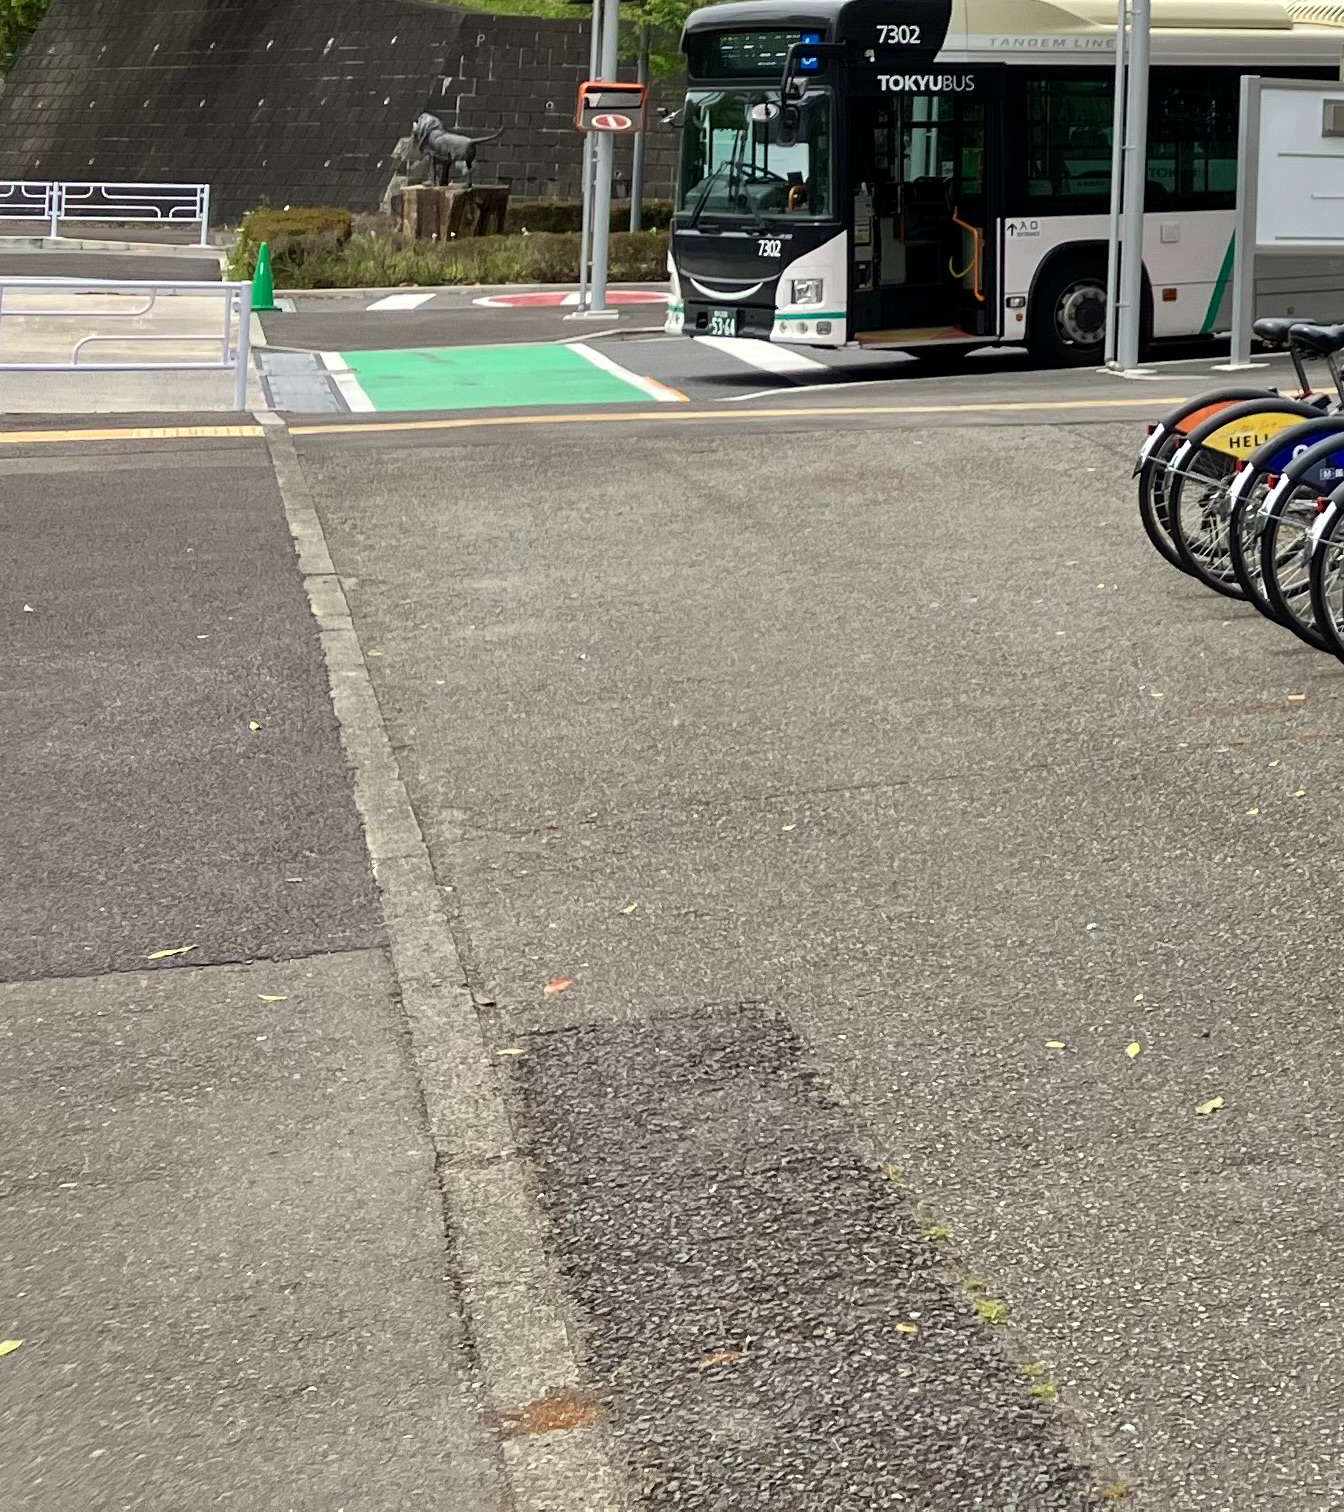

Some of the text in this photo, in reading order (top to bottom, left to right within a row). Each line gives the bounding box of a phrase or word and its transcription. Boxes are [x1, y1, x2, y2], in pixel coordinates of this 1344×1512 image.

[876, 25, 921, 44] 7302
[989, 38, 1114, 48] TANDEM LINE
[877, 75, 975, 92] TOKYUBUS
[757, 239, 781, 257] 7302
